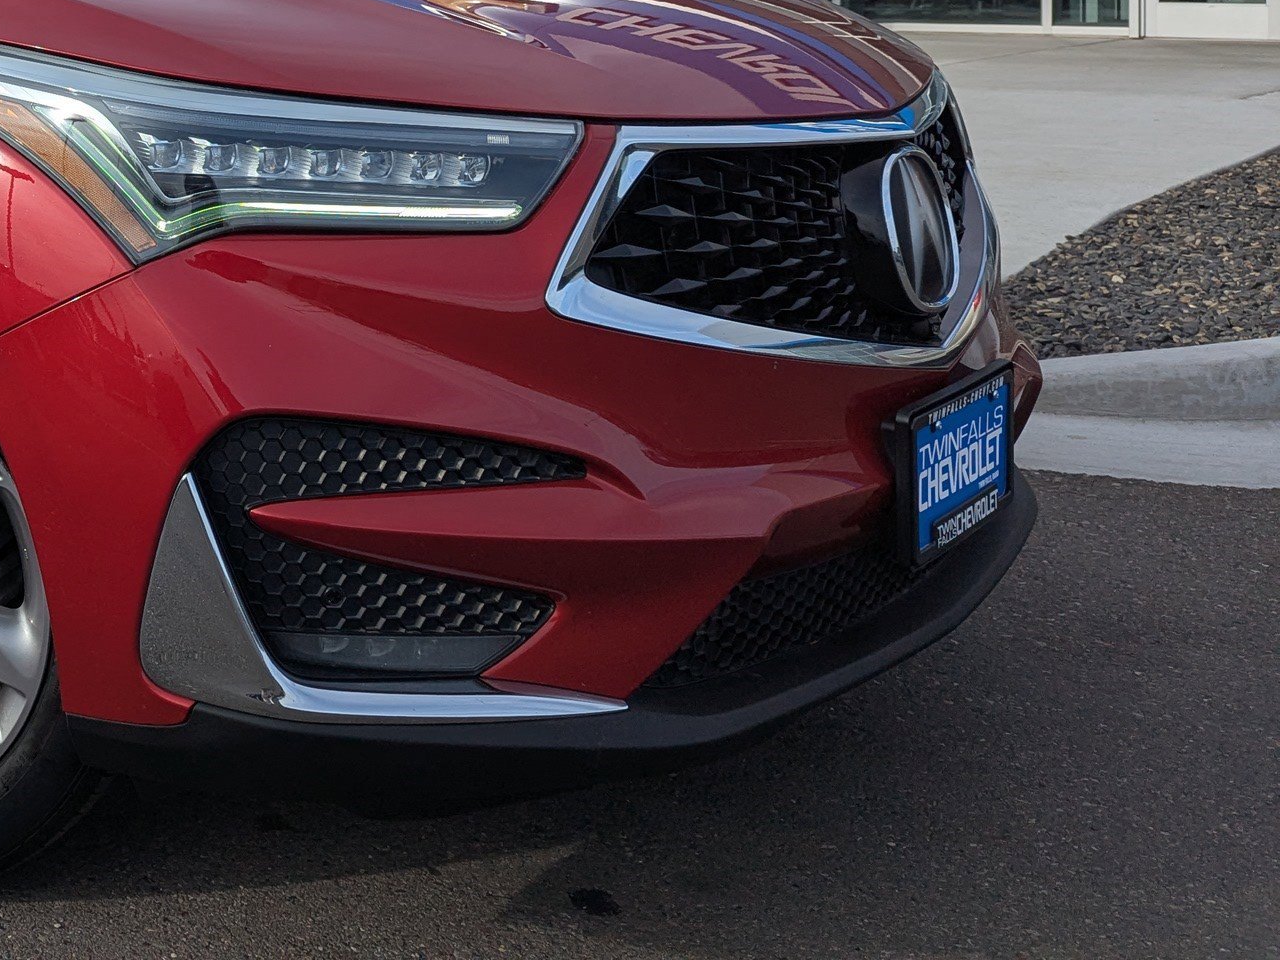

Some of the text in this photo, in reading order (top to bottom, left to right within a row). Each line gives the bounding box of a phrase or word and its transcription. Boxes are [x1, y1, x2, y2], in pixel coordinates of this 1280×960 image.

[920, 405, 1003, 469] TWINFALLS
[918, 427, 1003, 513] CHEVROLET
[937, 515, 957, 538] TWIN
[956, 488, 999, 535] CHEVROLET
[937, 527, 958, 549] FALLS
